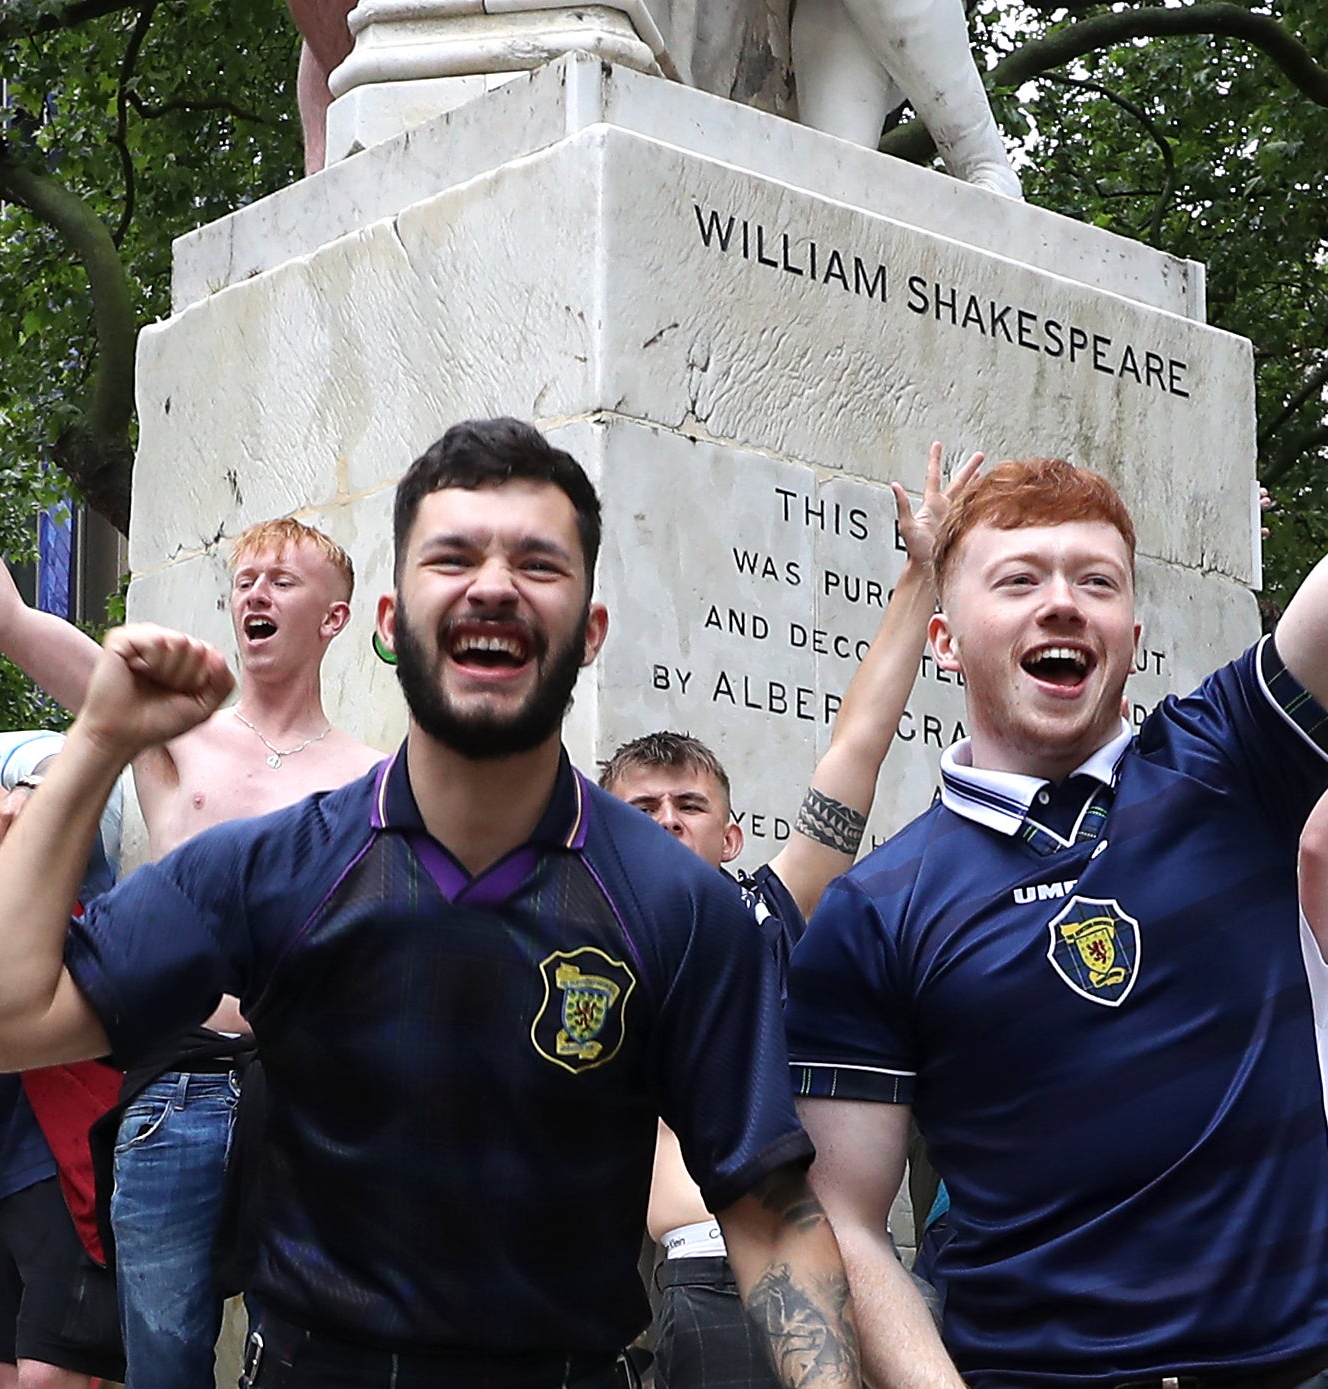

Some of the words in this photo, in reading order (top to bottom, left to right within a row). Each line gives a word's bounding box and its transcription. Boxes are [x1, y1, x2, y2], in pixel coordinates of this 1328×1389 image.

[693, 204, 888, 302] WILLIAM
[907, 275, 1191, 398] SHAKESPEARE
[775, 487, 868, 540] THIS
[733, 547, 801, 586] WAS
[704, 605, 769, 639] AND
[653, 664, 692, 694] BY
[712, 670, 843, 725] ALBER
[897, 710, 968, 749] GRA
